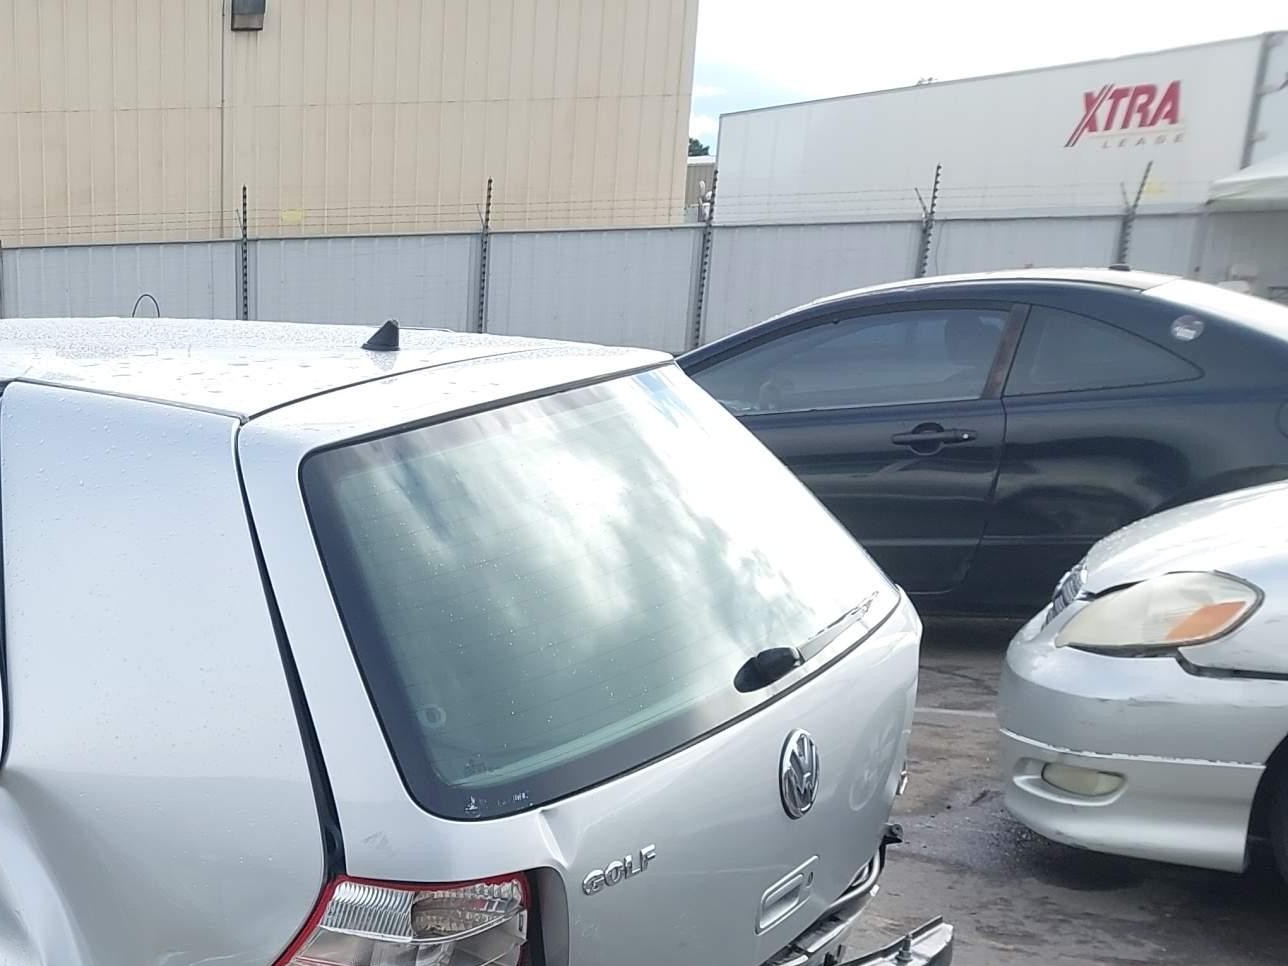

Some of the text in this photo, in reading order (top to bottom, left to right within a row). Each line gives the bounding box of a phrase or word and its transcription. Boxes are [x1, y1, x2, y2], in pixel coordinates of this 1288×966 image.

[1065, 80, 1181, 147] XTRA
[1102, 133, 1185, 149] LEASE
[583, 843, 657, 896] GOLF
